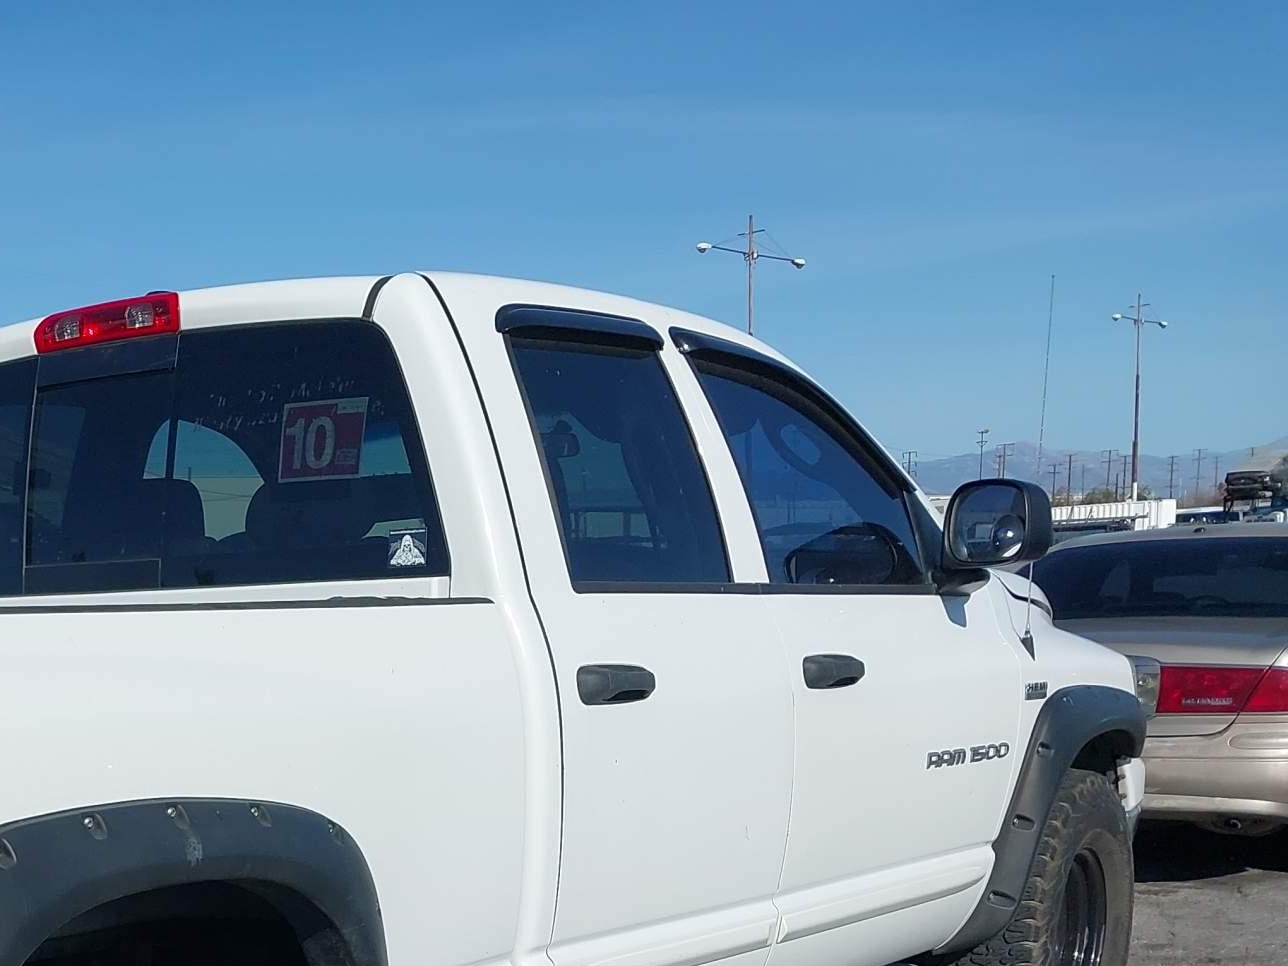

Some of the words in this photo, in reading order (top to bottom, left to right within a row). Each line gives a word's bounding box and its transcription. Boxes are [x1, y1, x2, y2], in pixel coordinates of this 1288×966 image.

[285, 415, 336, 470] 10
[926, 748, 967, 770] RAM
[969, 742, 1010, 763] 1500
